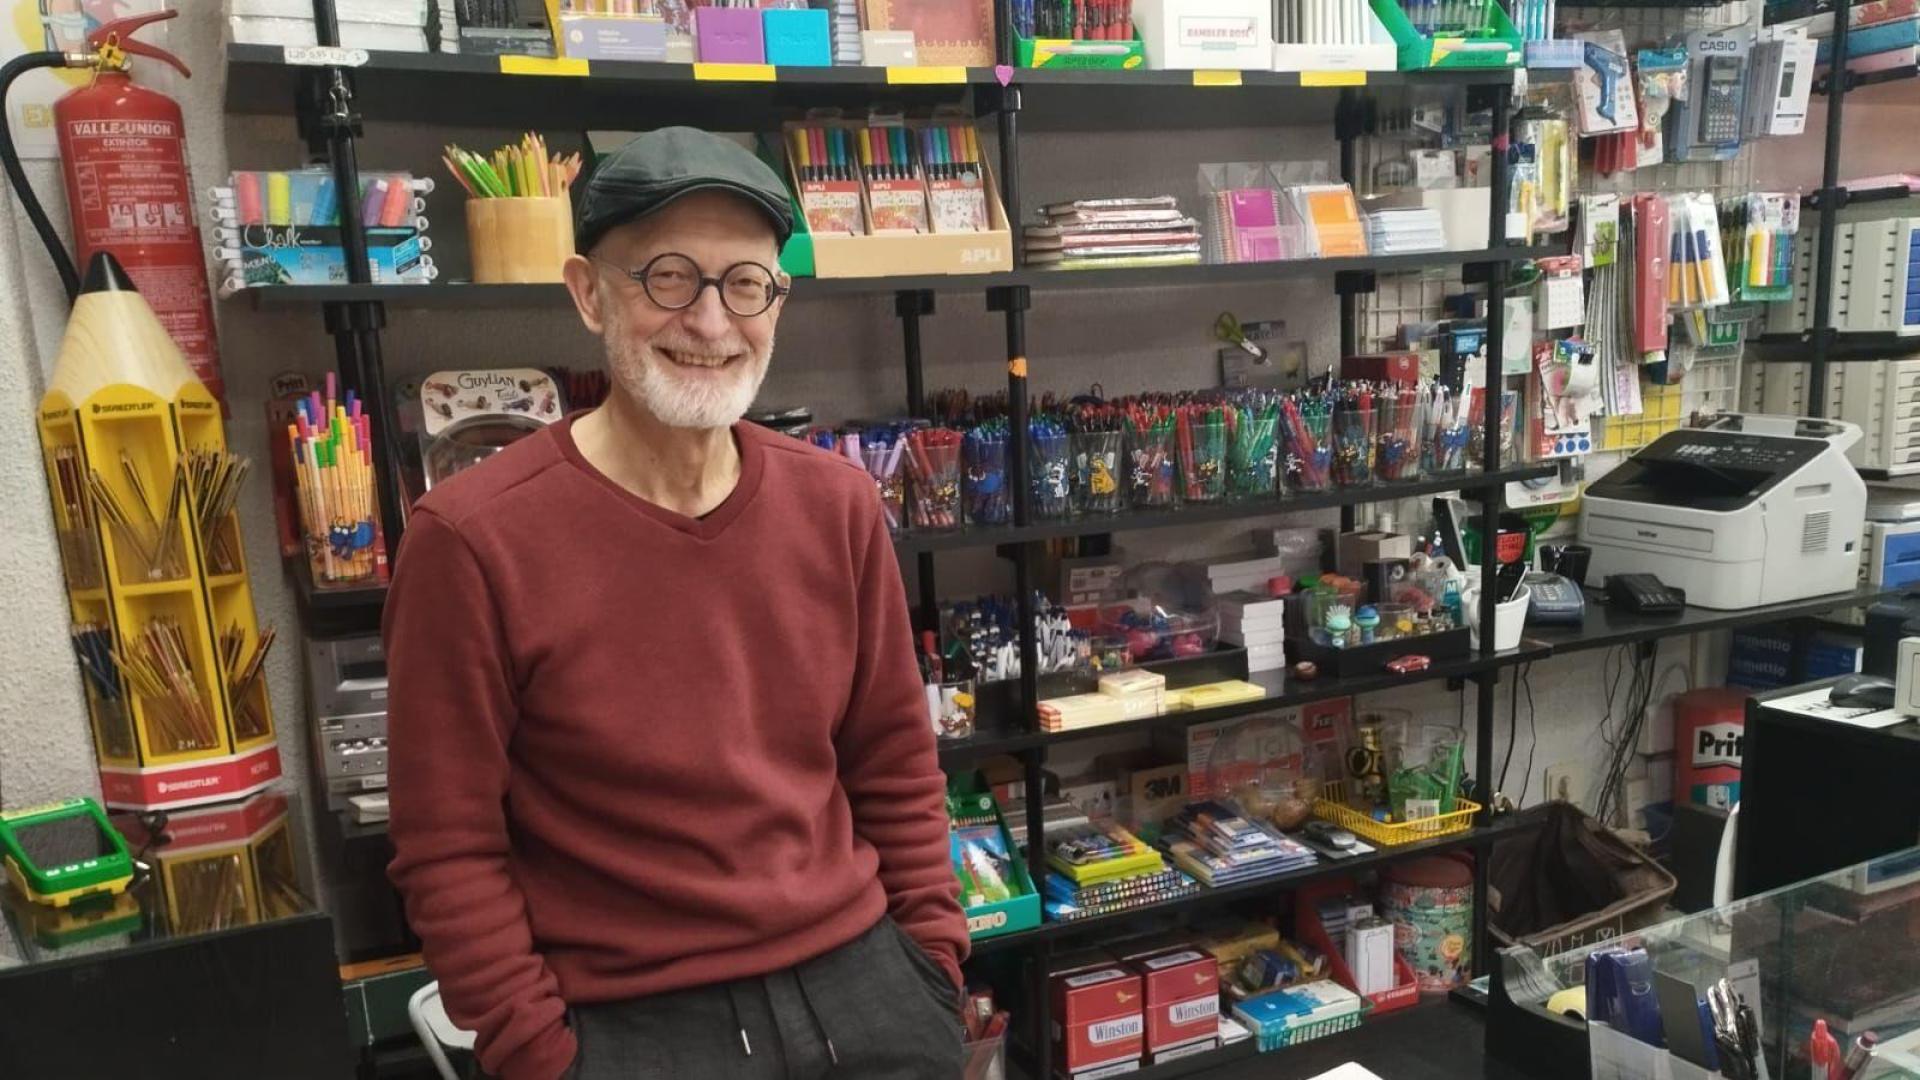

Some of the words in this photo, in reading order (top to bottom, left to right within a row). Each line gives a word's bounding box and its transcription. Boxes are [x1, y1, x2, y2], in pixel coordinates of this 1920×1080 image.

[1699, 40, 1737, 52] CASIO
[74, 121, 171, 136] VALLE-UNION
[102, 137, 149, 147] EXTINTOR
[807, 184, 826, 192] APLI
[873, 183, 891, 191] APLI
[932, 181, 950, 190] APLI
[245, 223, 302, 250] Chalk
[960, 248, 1001, 263] APLI
[1144, 775, 1181, 799] 3M
[1174, 1000, 1216, 1021] Winston
[1094, 1021, 1139, 1041] Winston
